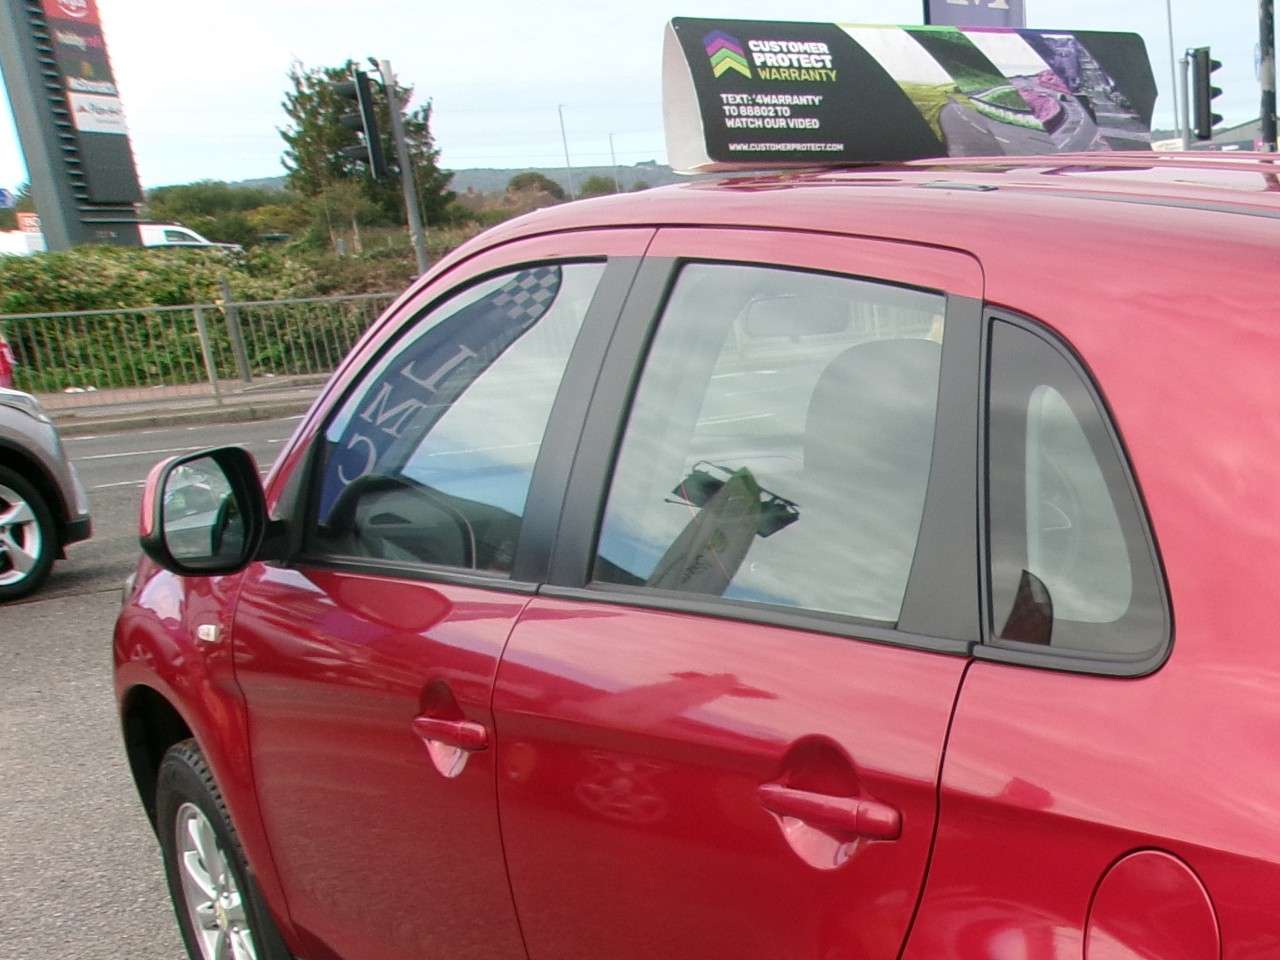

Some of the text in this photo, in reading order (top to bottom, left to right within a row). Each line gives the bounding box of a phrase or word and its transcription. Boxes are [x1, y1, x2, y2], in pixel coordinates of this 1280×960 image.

[748, 40, 830, 54] CUSTOMER
[752, 53, 833, 68] PROTECT
[757, 67, 838, 82] WARRANTY
[720, 93, 752, 104] TEXT:
[722, 106, 739, 116] TO
[776, 107, 791, 117] TO
[725, 118, 820, 129] WATCH OUR VIDEO
[728, 143, 844, 152] WWW.CUSTOMERPROTECT.COM
